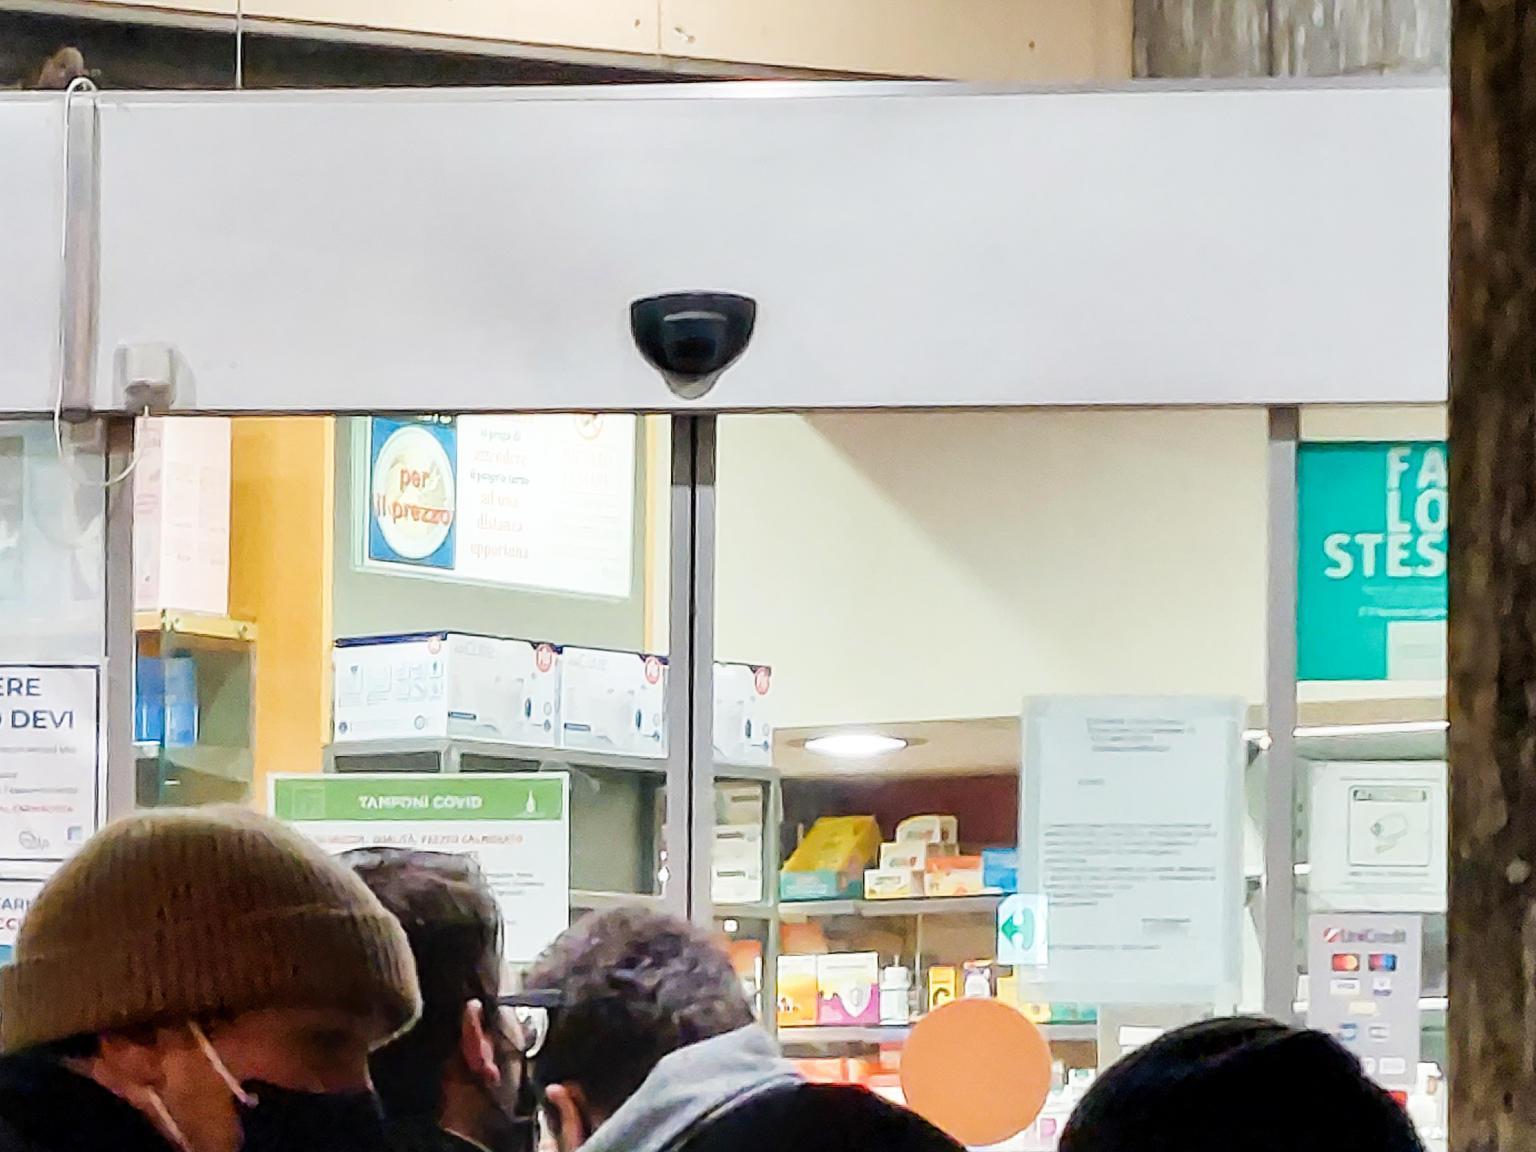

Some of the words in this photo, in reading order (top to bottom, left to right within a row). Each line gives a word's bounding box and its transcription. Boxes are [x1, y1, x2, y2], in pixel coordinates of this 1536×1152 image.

[400, 468, 430, 493] per
[391, 501, 452, 526] prezzo
[1385, 488, 1448, 533] LO
[11, 710, 75, 730] DEVI
[358, 794, 429, 809] TAMPONI
[432, 795, 482, 810] COVID
